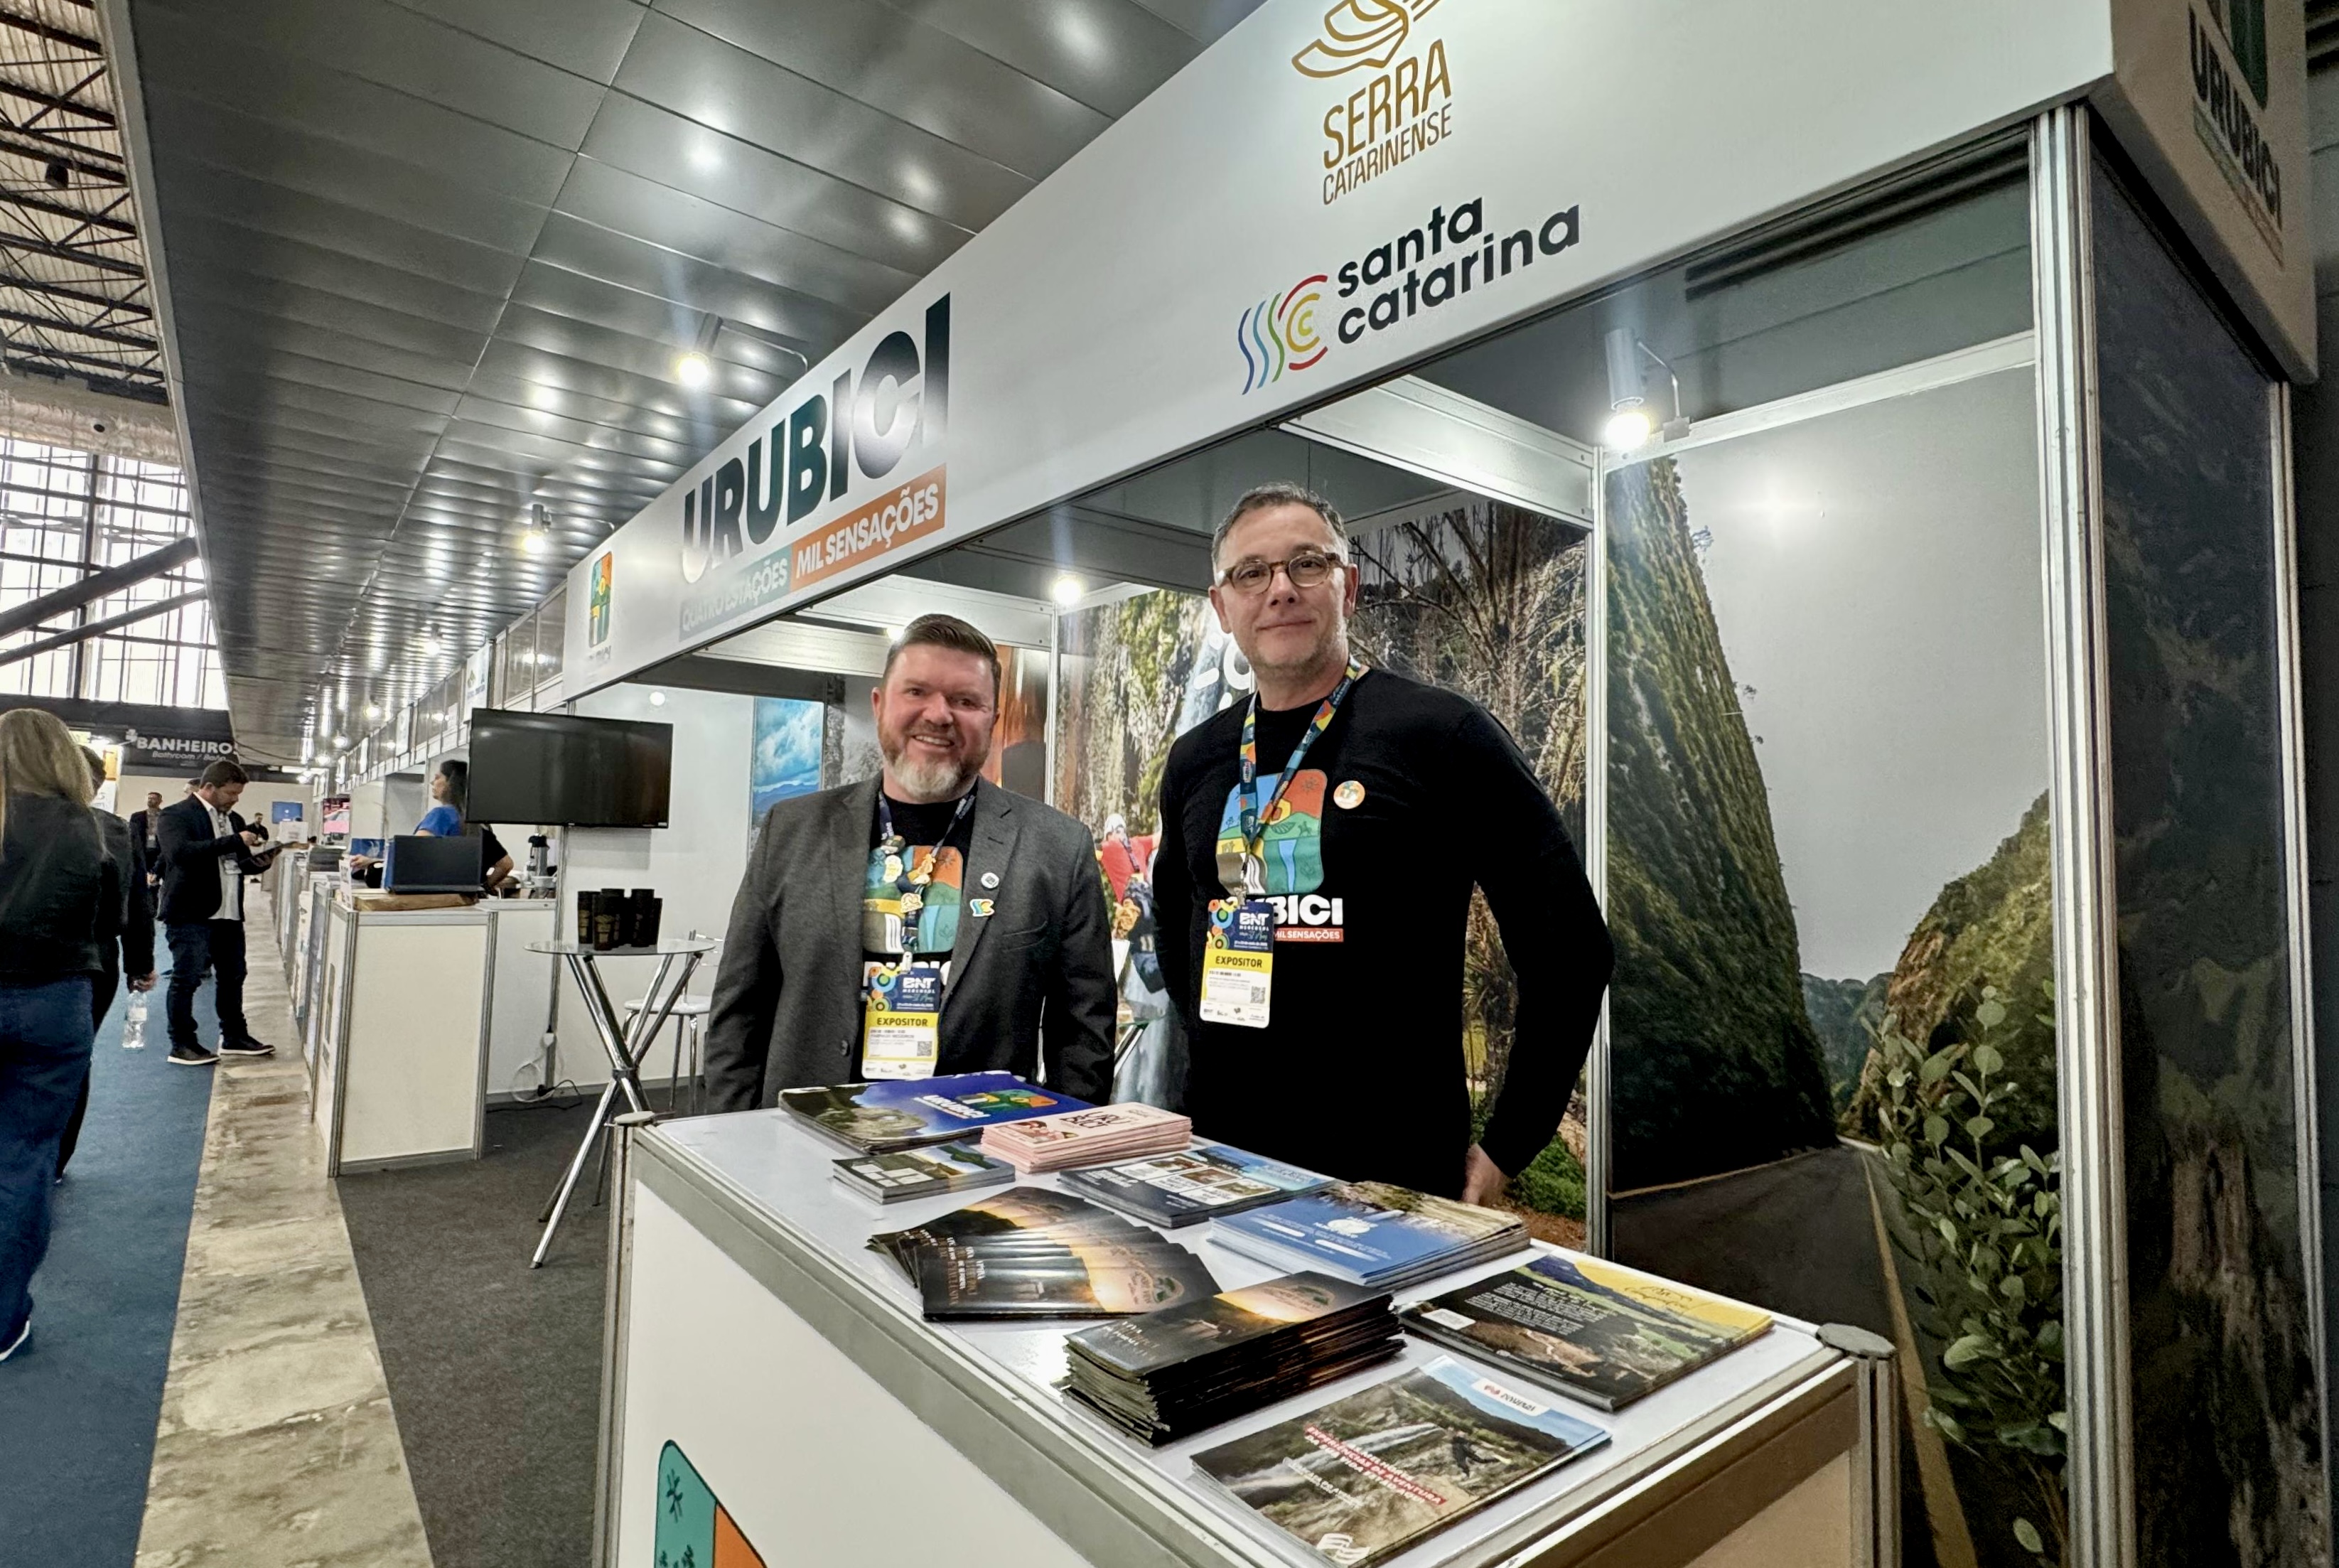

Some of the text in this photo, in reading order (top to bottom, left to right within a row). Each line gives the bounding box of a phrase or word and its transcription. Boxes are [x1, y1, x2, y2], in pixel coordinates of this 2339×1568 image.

[1323, 38, 1452, 169] SERRA
[2188, 1, 2283, 231] URUBICI
[1323, 102, 1452, 205] CATARINENSE
[1338, 197, 1483, 298] santa
[1338, 204, 1580, 345] catarina
[682, 291, 951, 584] URUBICI
[725, 557, 788, 612] ESTAÇÕES
[796, 544, 824, 580] MIL
[824, 482, 939, 564] SENSAÇÕES
[136, 736, 237, 755] BANHEIRO
[152, 751, 195, 761] Bathroom
[1240, 912, 1270, 926] BNT
[1265, 894, 1343, 925] BICI
[1287, 928, 1340, 940] SENSAÇÕES
[1215, 955, 1263, 968] EXPOSITOR
[903, 977, 936, 989] BNT
[876, 1017, 928, 1026] EXPOSITOR
[1370, 1465, 1387, 1477] DE
[1385, 1473, 1441, 1504] AVENTURA
